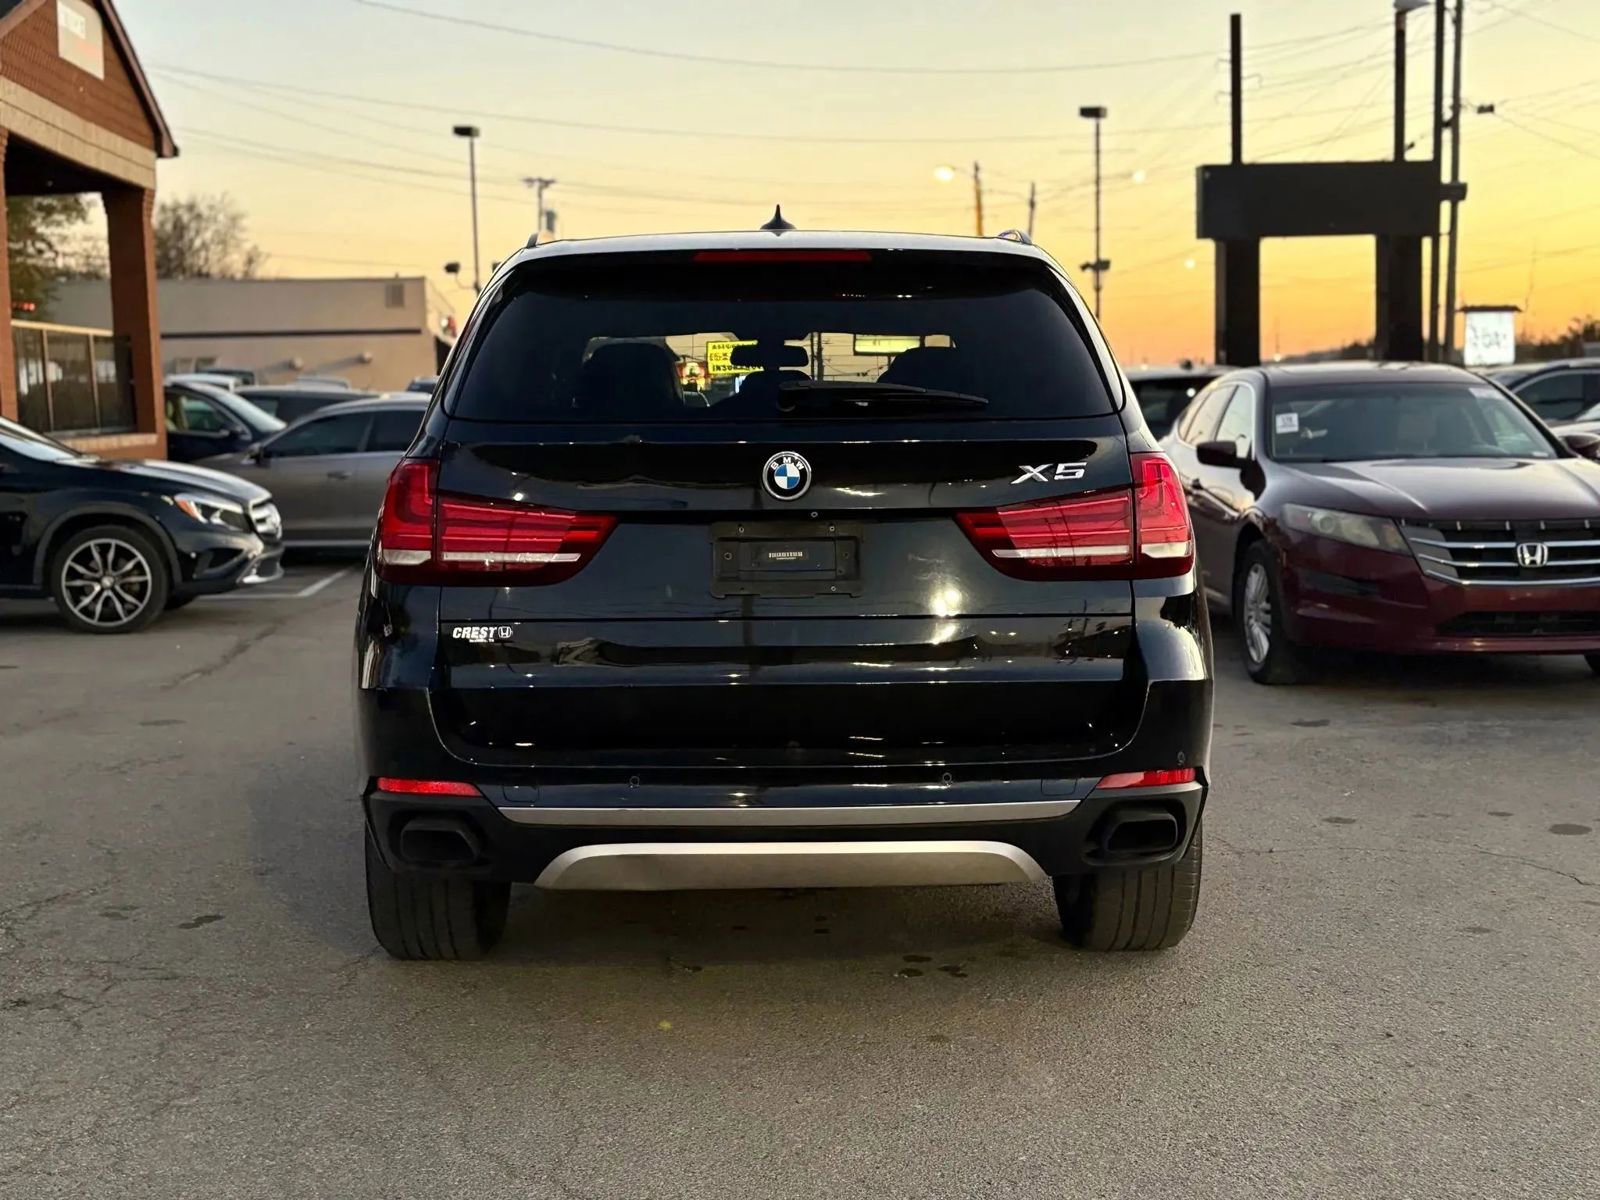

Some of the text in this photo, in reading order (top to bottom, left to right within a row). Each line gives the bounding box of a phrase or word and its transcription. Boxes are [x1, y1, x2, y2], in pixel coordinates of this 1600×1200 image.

[770, 457, 804, 470] BMW
[1011, 462, 1088, 484] X5
[452, 626, 497, 639] CREST
